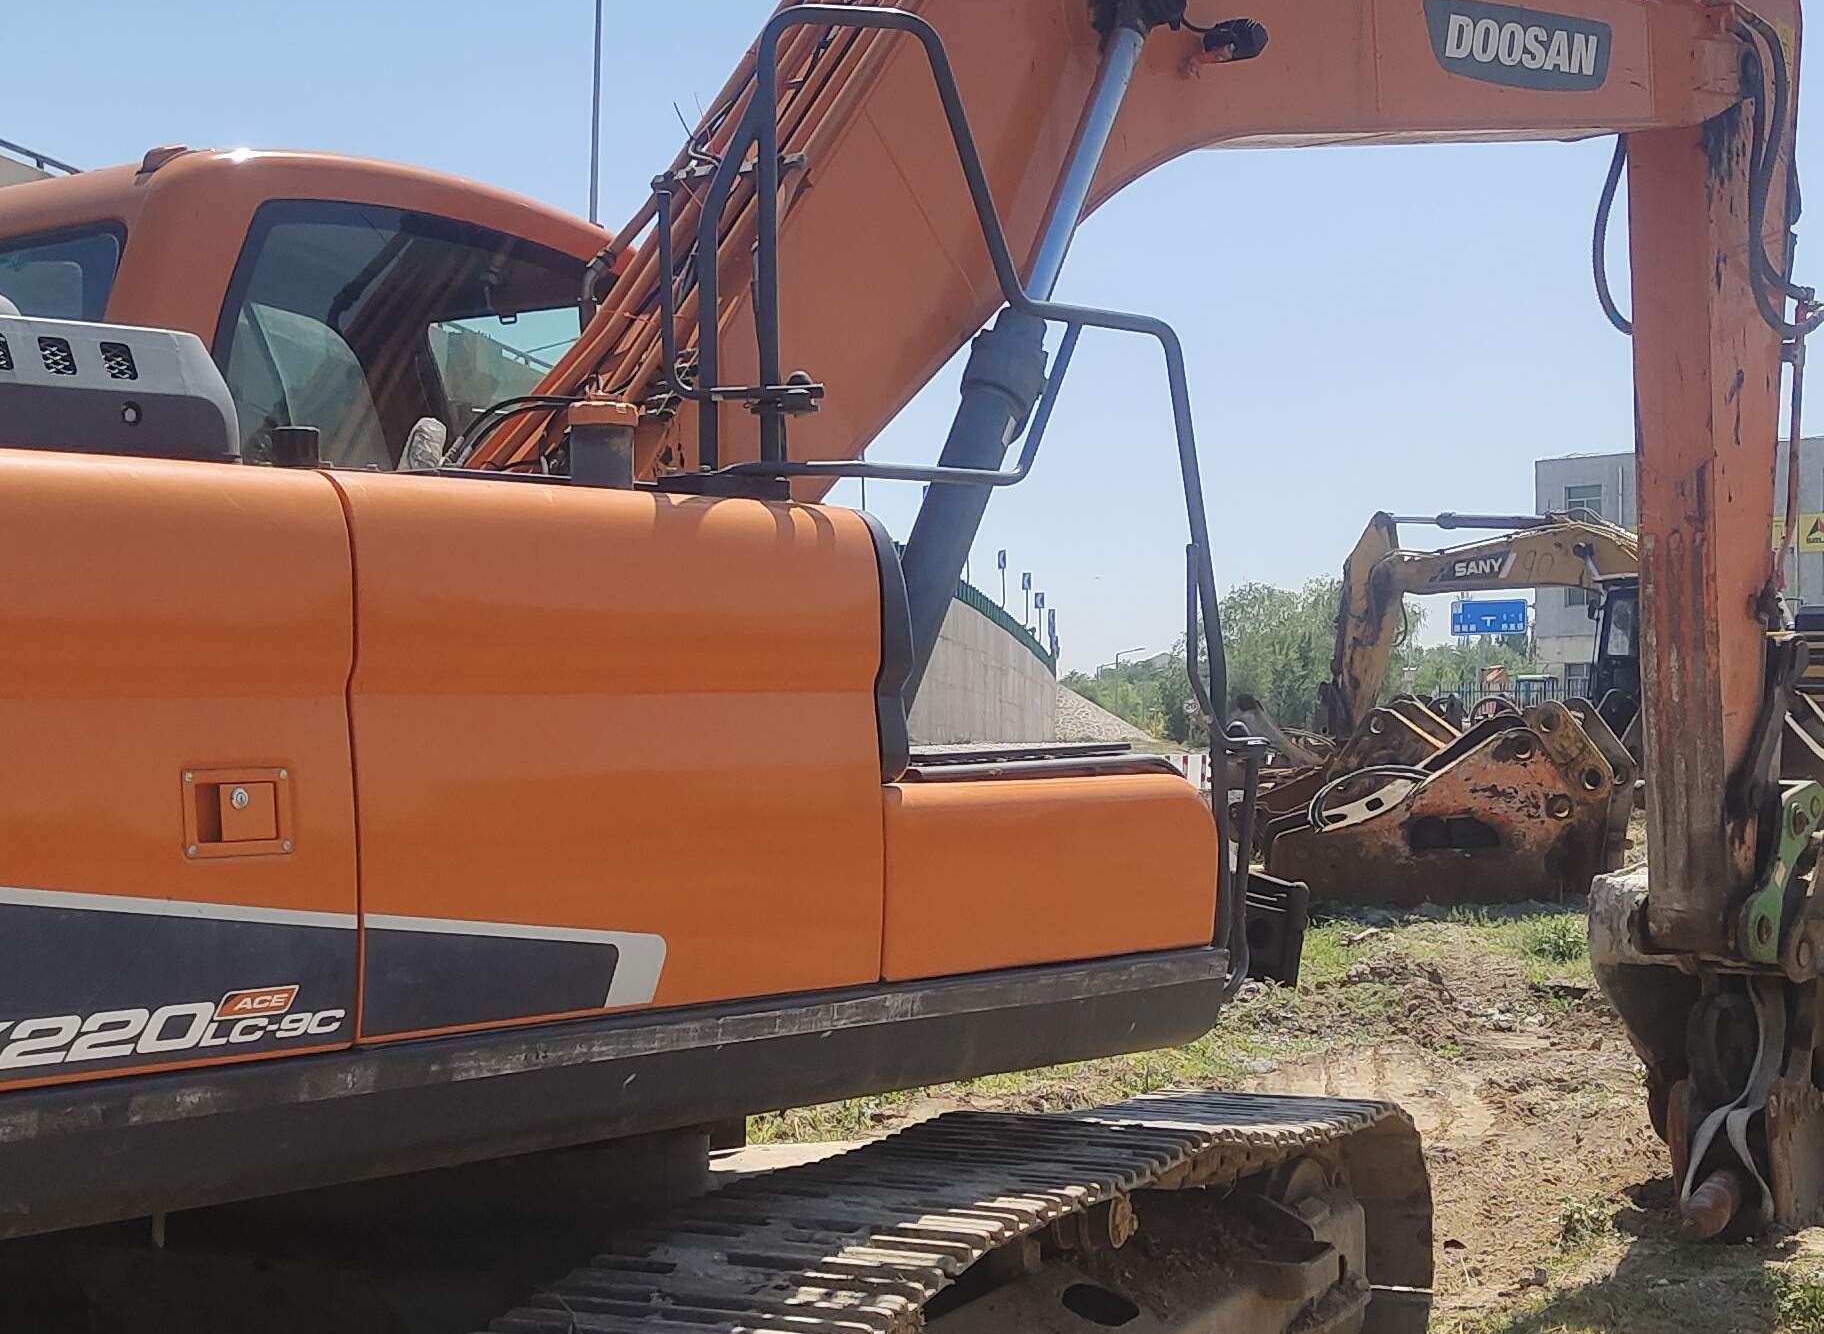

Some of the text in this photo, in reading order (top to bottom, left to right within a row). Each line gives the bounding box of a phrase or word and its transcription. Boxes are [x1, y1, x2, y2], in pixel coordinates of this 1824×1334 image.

[1445, 13, 1599, 76] DOOSAN
[1454, 557, 1503, 577] SANY
[233, 993, 289, 1011] ACE
